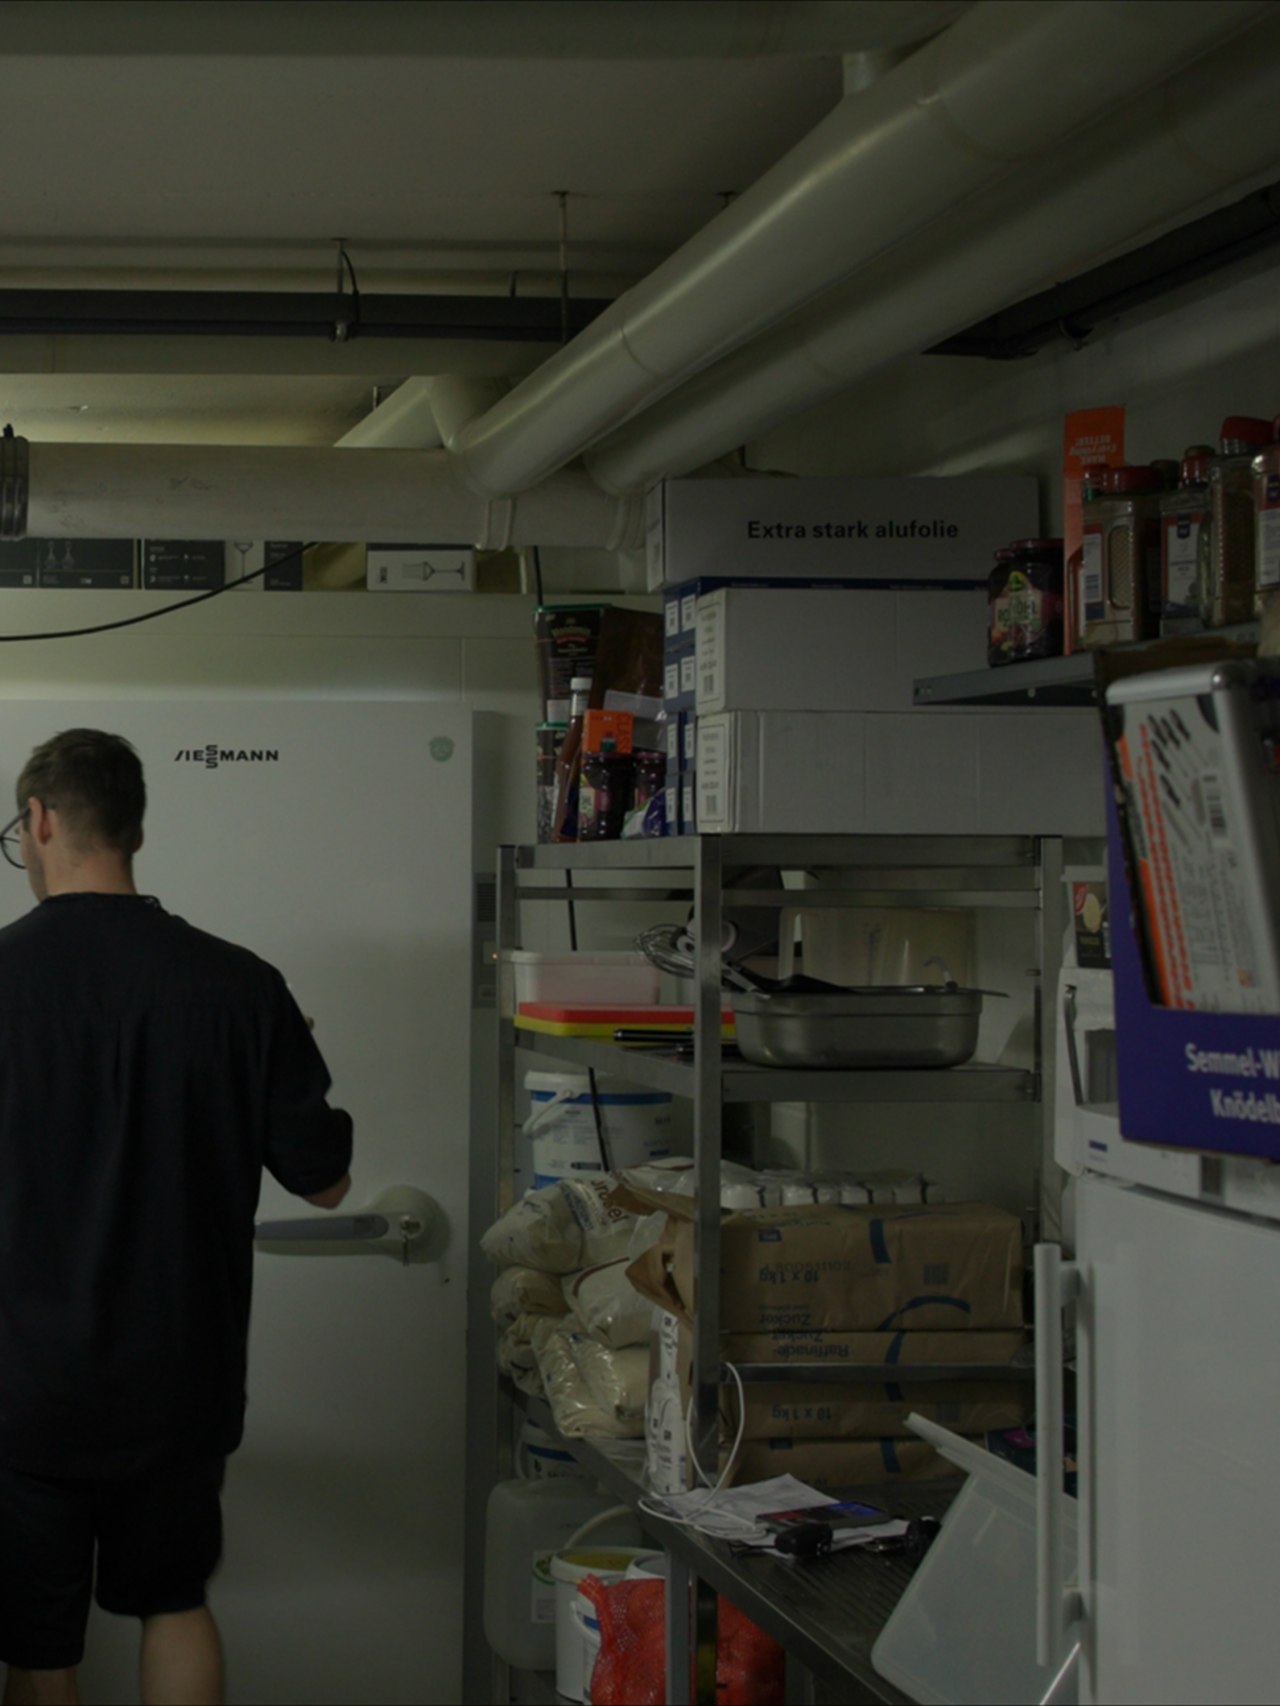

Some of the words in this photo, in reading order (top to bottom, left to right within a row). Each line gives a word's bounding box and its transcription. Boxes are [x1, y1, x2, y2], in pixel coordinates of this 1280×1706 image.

[747, 520, 806, 540] Extra
[813, 520, 869, 539] stark
[875, 519, 959, 539] alufolie
[759, 1313, 812, 1326] Zucker
